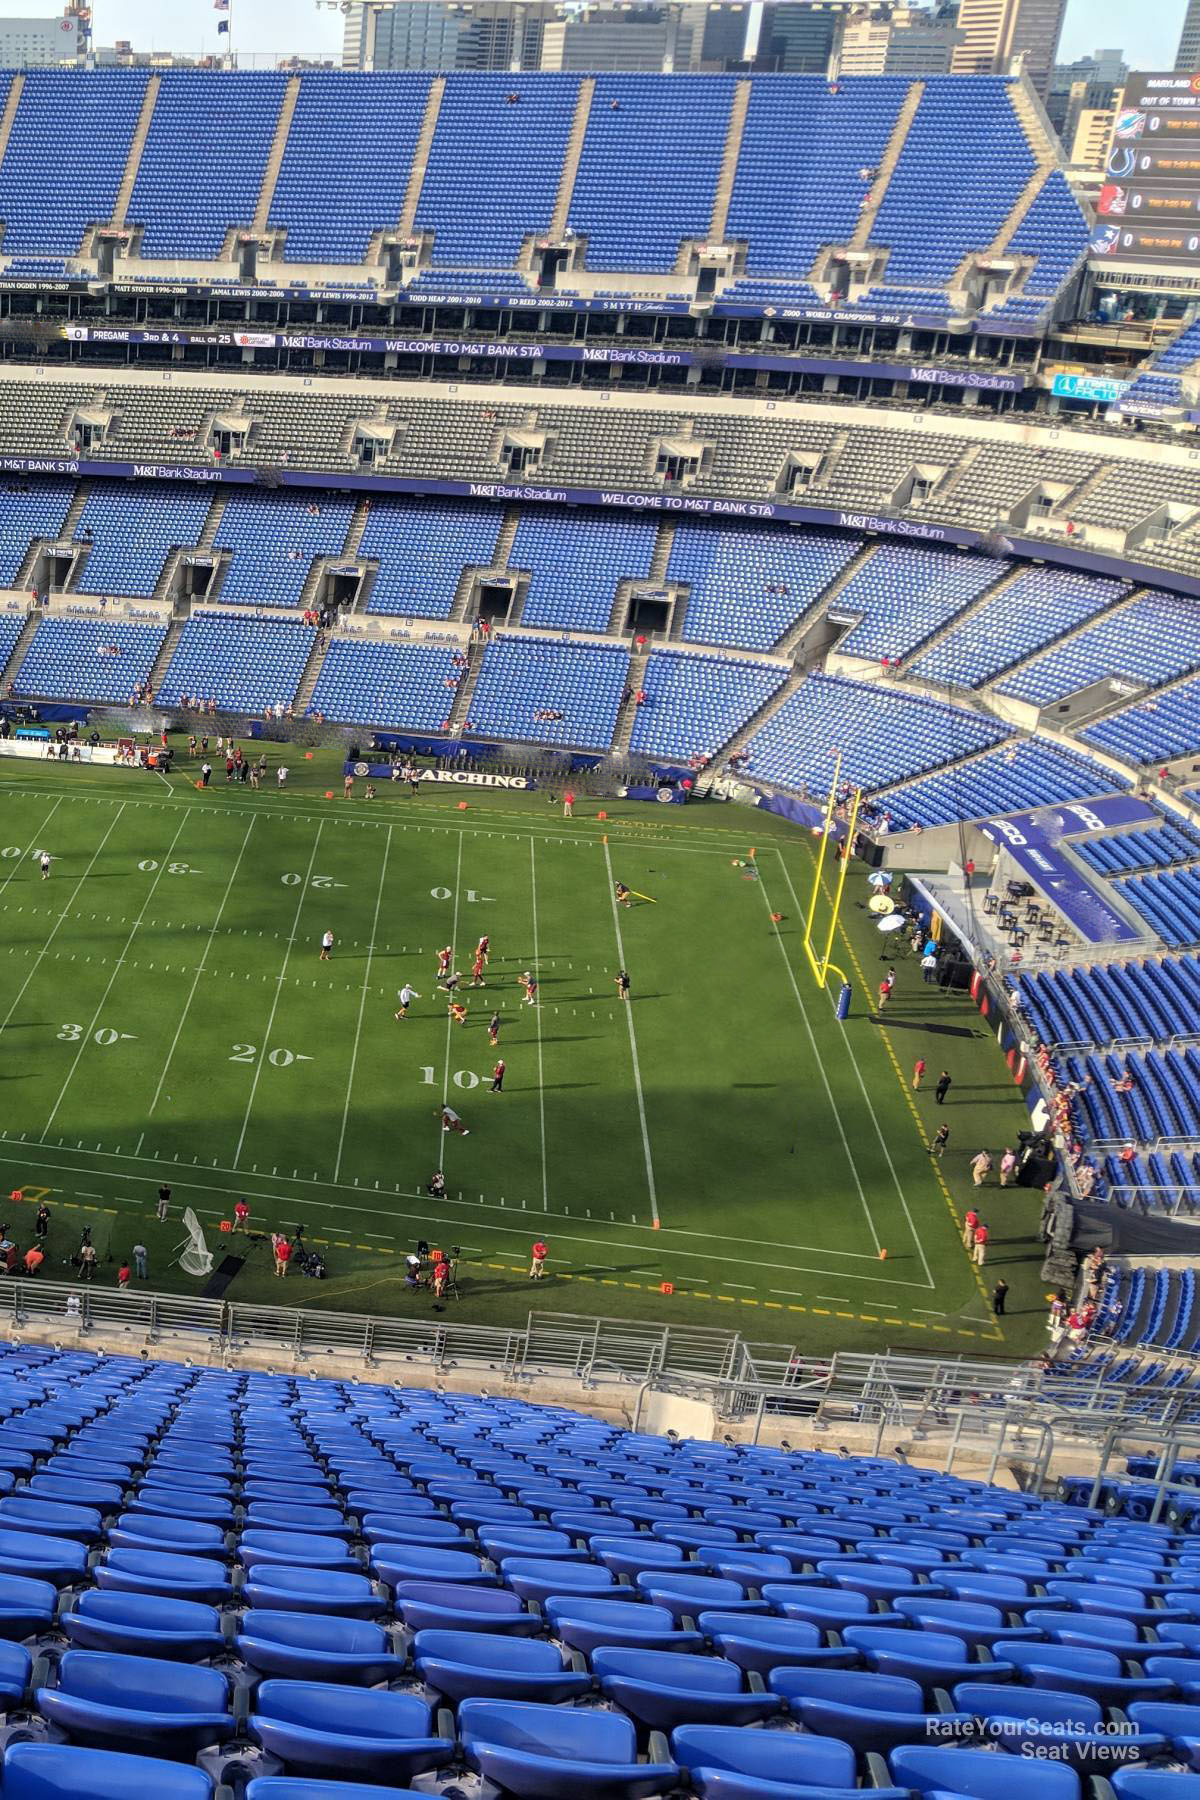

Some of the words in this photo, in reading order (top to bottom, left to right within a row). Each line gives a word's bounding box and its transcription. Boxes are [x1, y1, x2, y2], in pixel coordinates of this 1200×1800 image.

[1140, 96, 1158, 106] OUT
[1149, 116, 1160, 131] 0
[1141, 156, 1151, 170] 0
[1131, 195, 1142, 208] 0
[1123, 234, 1133, 247] 0
[16, 282, 38, 290] OGDEN
[38, 283, 70, 291] 1996-2007
[114, 285, 130, 293] MATT
[131, 285, 154, 293] STOVER
[210, 288, 230, 296] JAMAL
[310, 291, 321, 299] RAY
[322, 292, 341, 300] LEWIS
[342, 293, 374, 301] 1996-2012
[409, 294, 427, 302] TODD
[428, 295, 445, 303] HEAP
[447, 296, 482, 304] 2001-2010
[509, 298, 518, 306] ED
[537, 300, 574, 308] 2002-2012
[782, 309, 801, 317] 2000
[805, 310, 832, 319] WORLD
[833, 312, 877, 321] CHAMPIONS
[880, 315, 900, 323] 2012
[74, 329, 82, 339] 0
[93, 331, 129, 341] PREGAME
[143, 332, 160, 342] 3RD
[161, 332, 171, 342] &
[172, 332, 179, 342] 4
[190, 335, 206, 344] BALL
[207, 336, 217, 344] ON
[218, 334, 231, 344] 25
[282, 336, 307, 347] M&T
[307, 337, 331, 349] Bank
[331, 338, 371, 350] Stadium
[386, 341, 441, 353] WELCOME
[443, 343, 459, 353] TO
[461, 343, 486, 355] M&T
[488, 345, 518, 356] BANK
[910, 368, 939, 381] M&T
[938, 370, 967, 384] Bank
[967, 373, 1015, 389] Stadium
[1076, 378, 1131, 390] STRATEG
[4, 460, 26, 470] M&T
[28, 461, 56, 472] BANK
[133, 465, 159, 476] M&T
[158, 466, 183, 478] Bank
[183, 468, 222, 481] Stadium
[601, 493, 662, 507] WELCOME
[665, 498, 682, 509] TO
[685, 500, 711, 511] M&T
[713, 502, 747, 514] BANK
[840, 513, 869, 528] M&T
[869, 515, 897, 532] Bank
[897, 521, 945, 540] Stadium
[400, 767, 530, 790] ARCHING
[56, 1023, 118, 1045] 30
[228, 1043, 294, 1067] 20
[418, 1066, 479, 1090] 10
